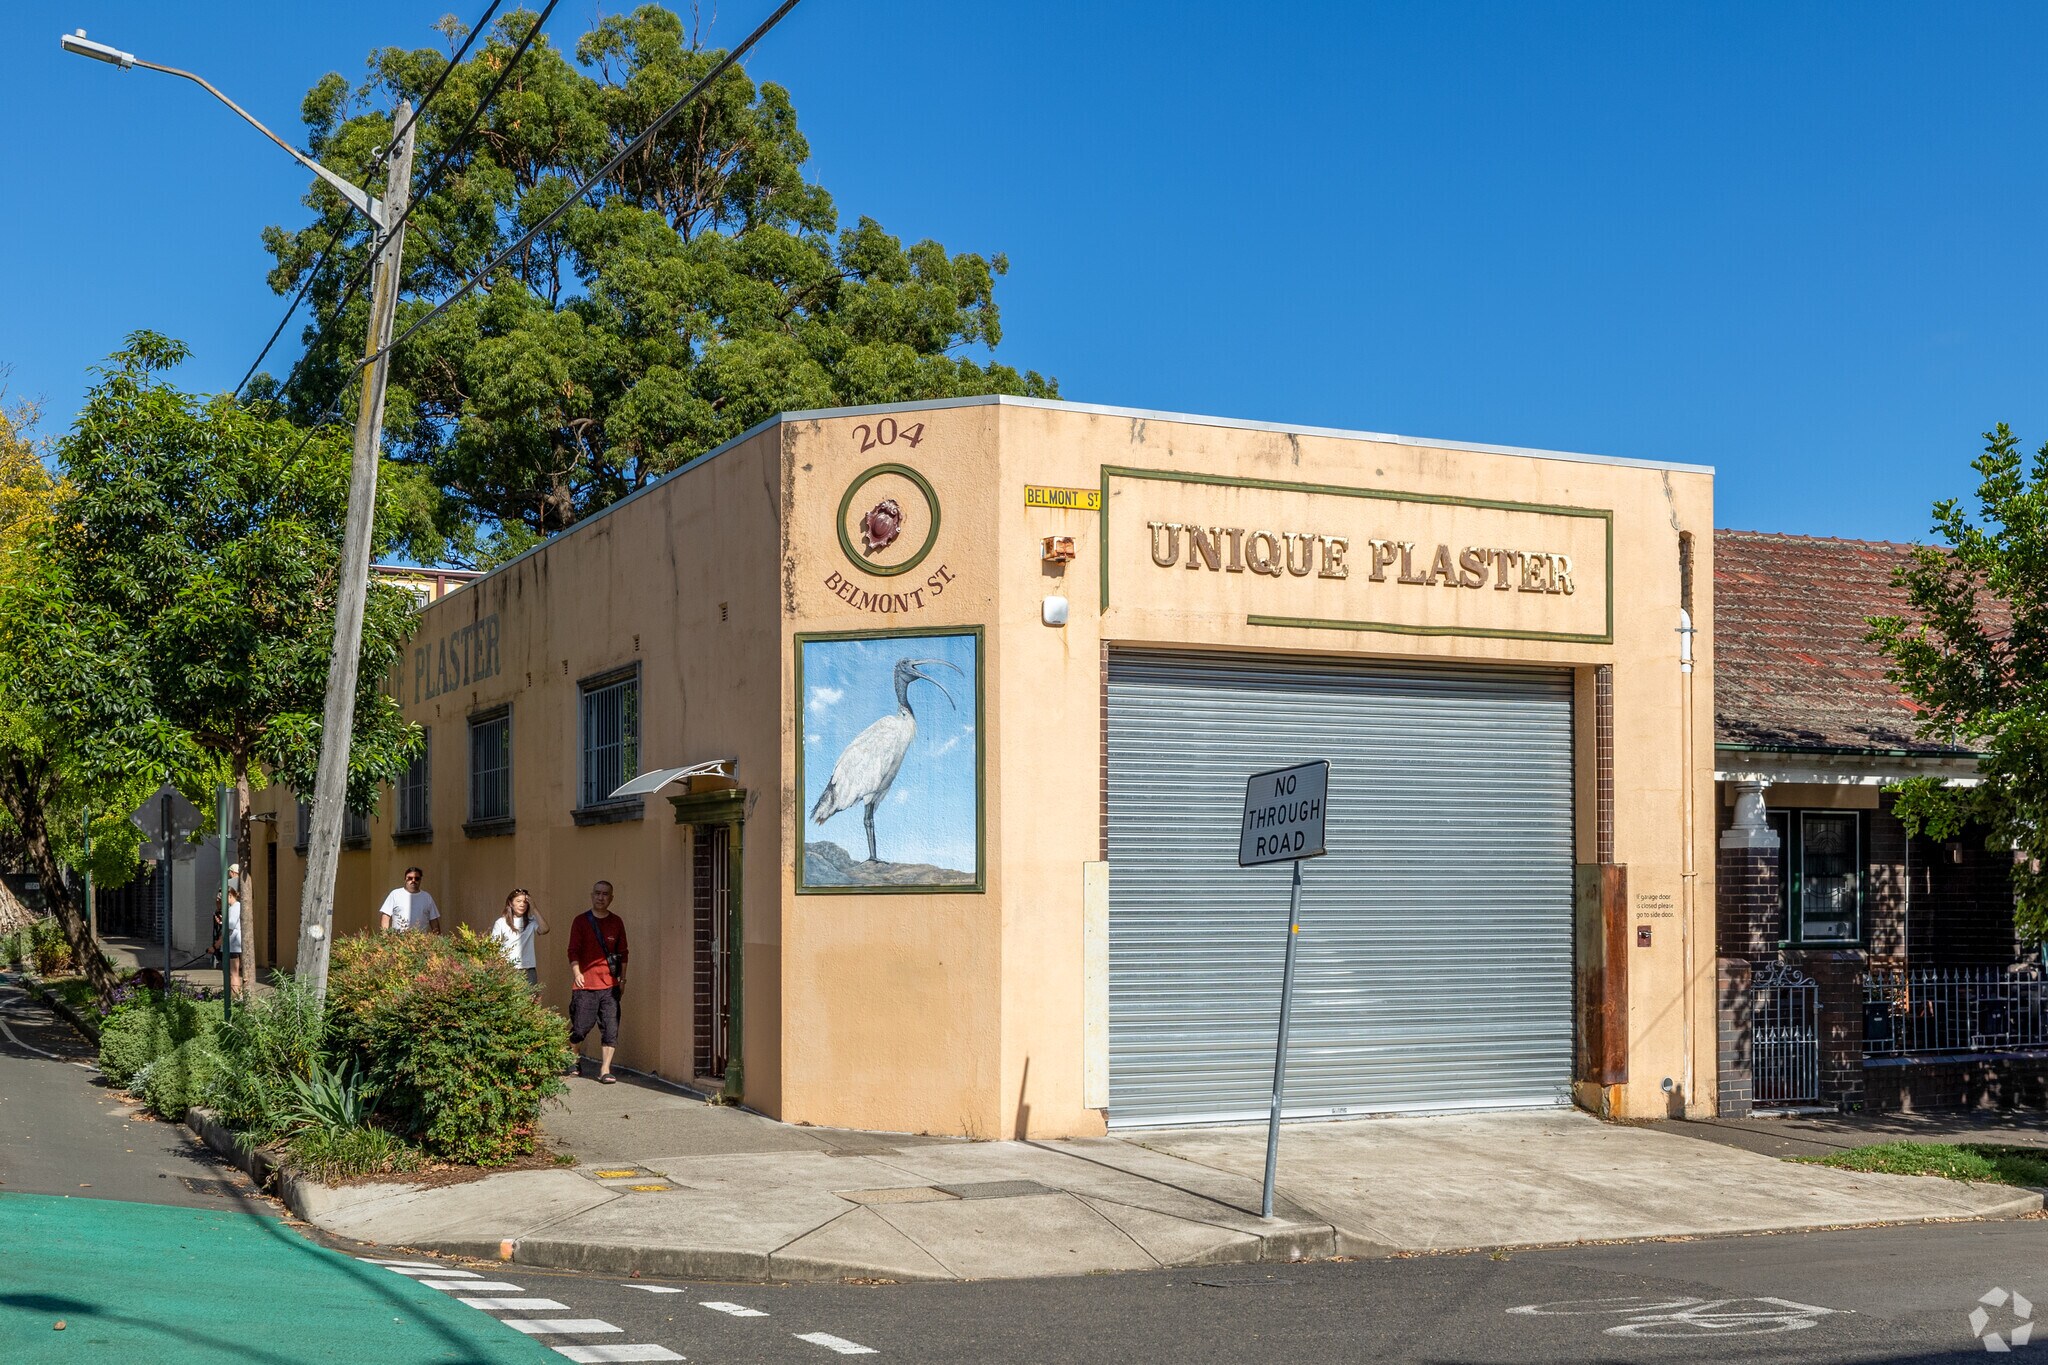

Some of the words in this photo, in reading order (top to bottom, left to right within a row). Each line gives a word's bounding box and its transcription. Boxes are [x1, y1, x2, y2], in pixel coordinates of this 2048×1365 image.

[852, 417, 925, 453] 204
[1027, 488, 1078, 506] BELMONT
[1146, 521, 1350, 579] UNIQUE
[1368, 538, 1576, 595] PLASTER
[824, 570, 925, 613] BELMONT
[927, 564, 956, 597] ST.
[414, 613, 502, 705] PLASTER
[1274, 774, 1297, 797] NO
[1249, 798, 1320, 830] THROUGH
[1256, 830, 1305, 857] ROAD
